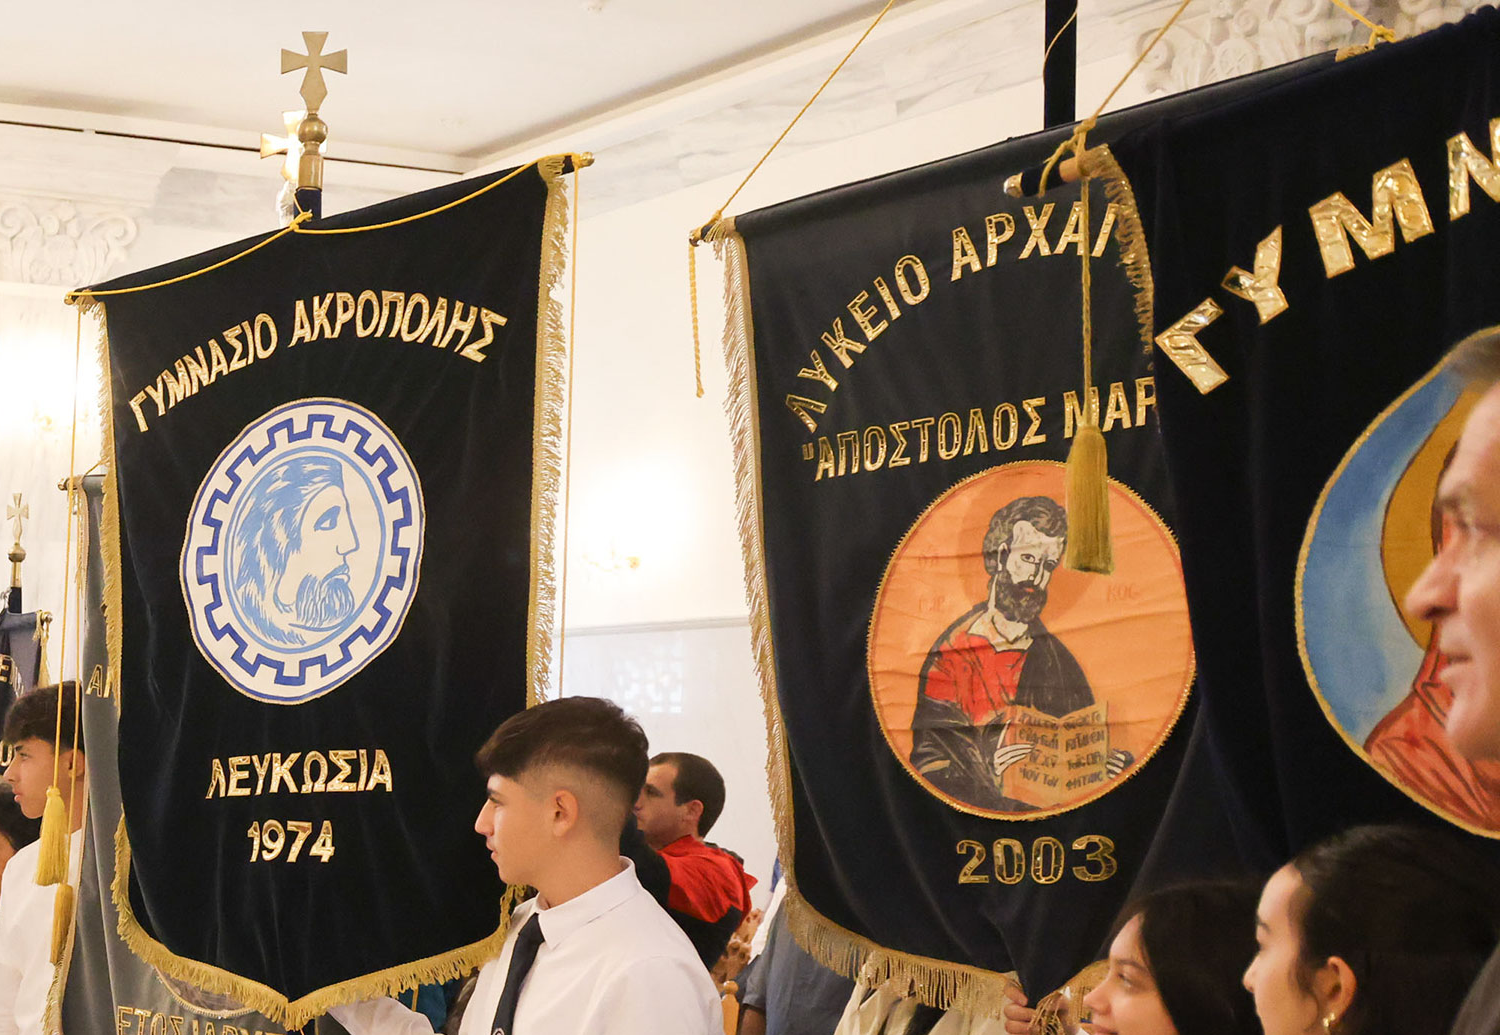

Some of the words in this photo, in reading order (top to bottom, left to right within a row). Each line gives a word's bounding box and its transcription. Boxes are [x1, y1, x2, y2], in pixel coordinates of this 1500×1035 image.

[1153, 116, 1500, 396] ΓΥΜΝ
[128, 312, 279, 432] ΓΥΜΝΑΣΙΟ
[287, 289, 509, 363] ΑΚΡΟΠΟΛΗΣ
[785, 254, 931, 434] ΛΥΚΕΙΟ
[1062, 375, 1157, 439] ΜΑΡ
[205, 748, 393, 799] ΛΕΥΚΩΣΙΑ
[247, 818, 335, 863] 1974
[956, 834, 1118, 885] 2003
